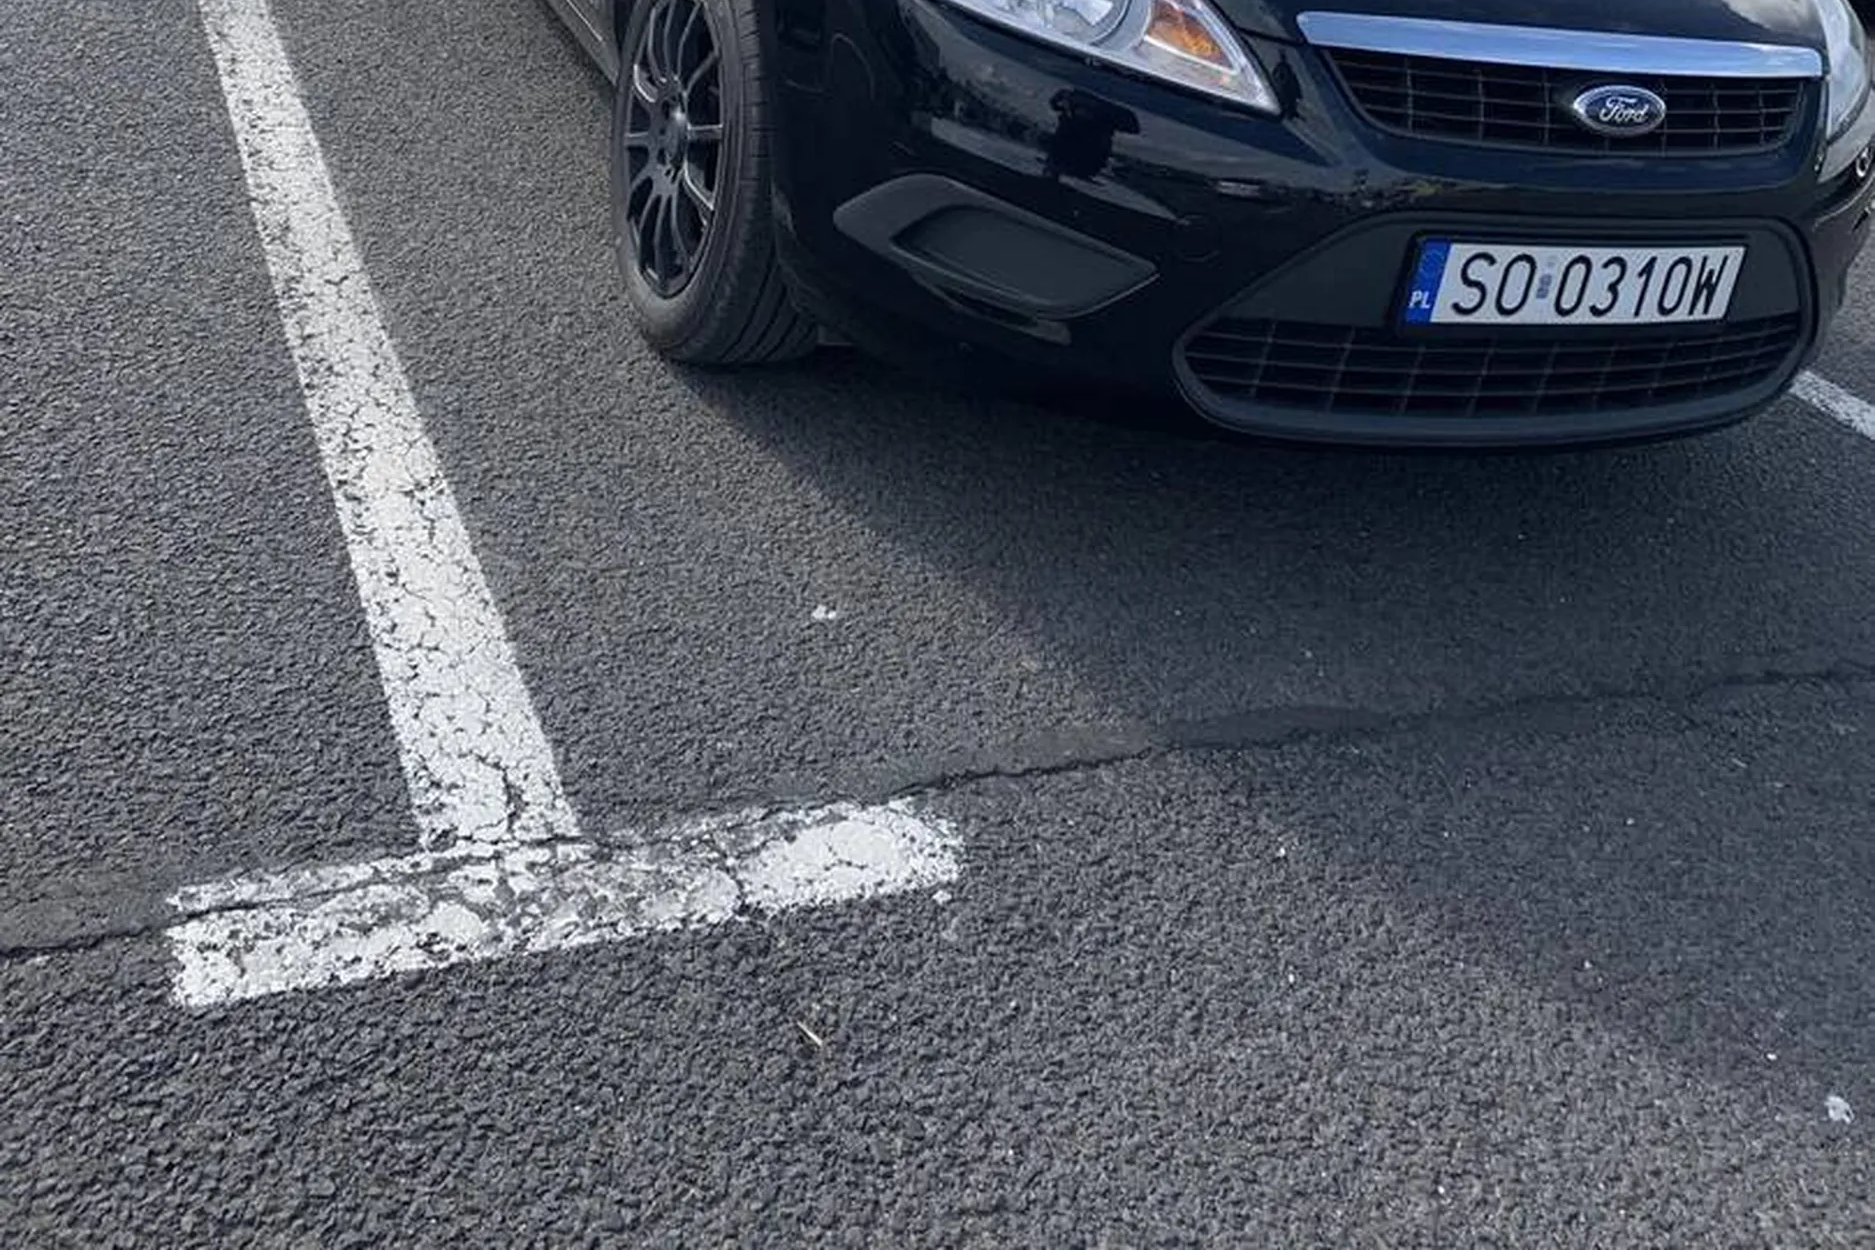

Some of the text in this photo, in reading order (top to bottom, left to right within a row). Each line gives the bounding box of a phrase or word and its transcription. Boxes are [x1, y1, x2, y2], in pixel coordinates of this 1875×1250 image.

[1599, 96, 1649, 122] Ford
[1451, 252, 1729, 317] SO 0310W
[1408, 290, 1432, 310] PL
